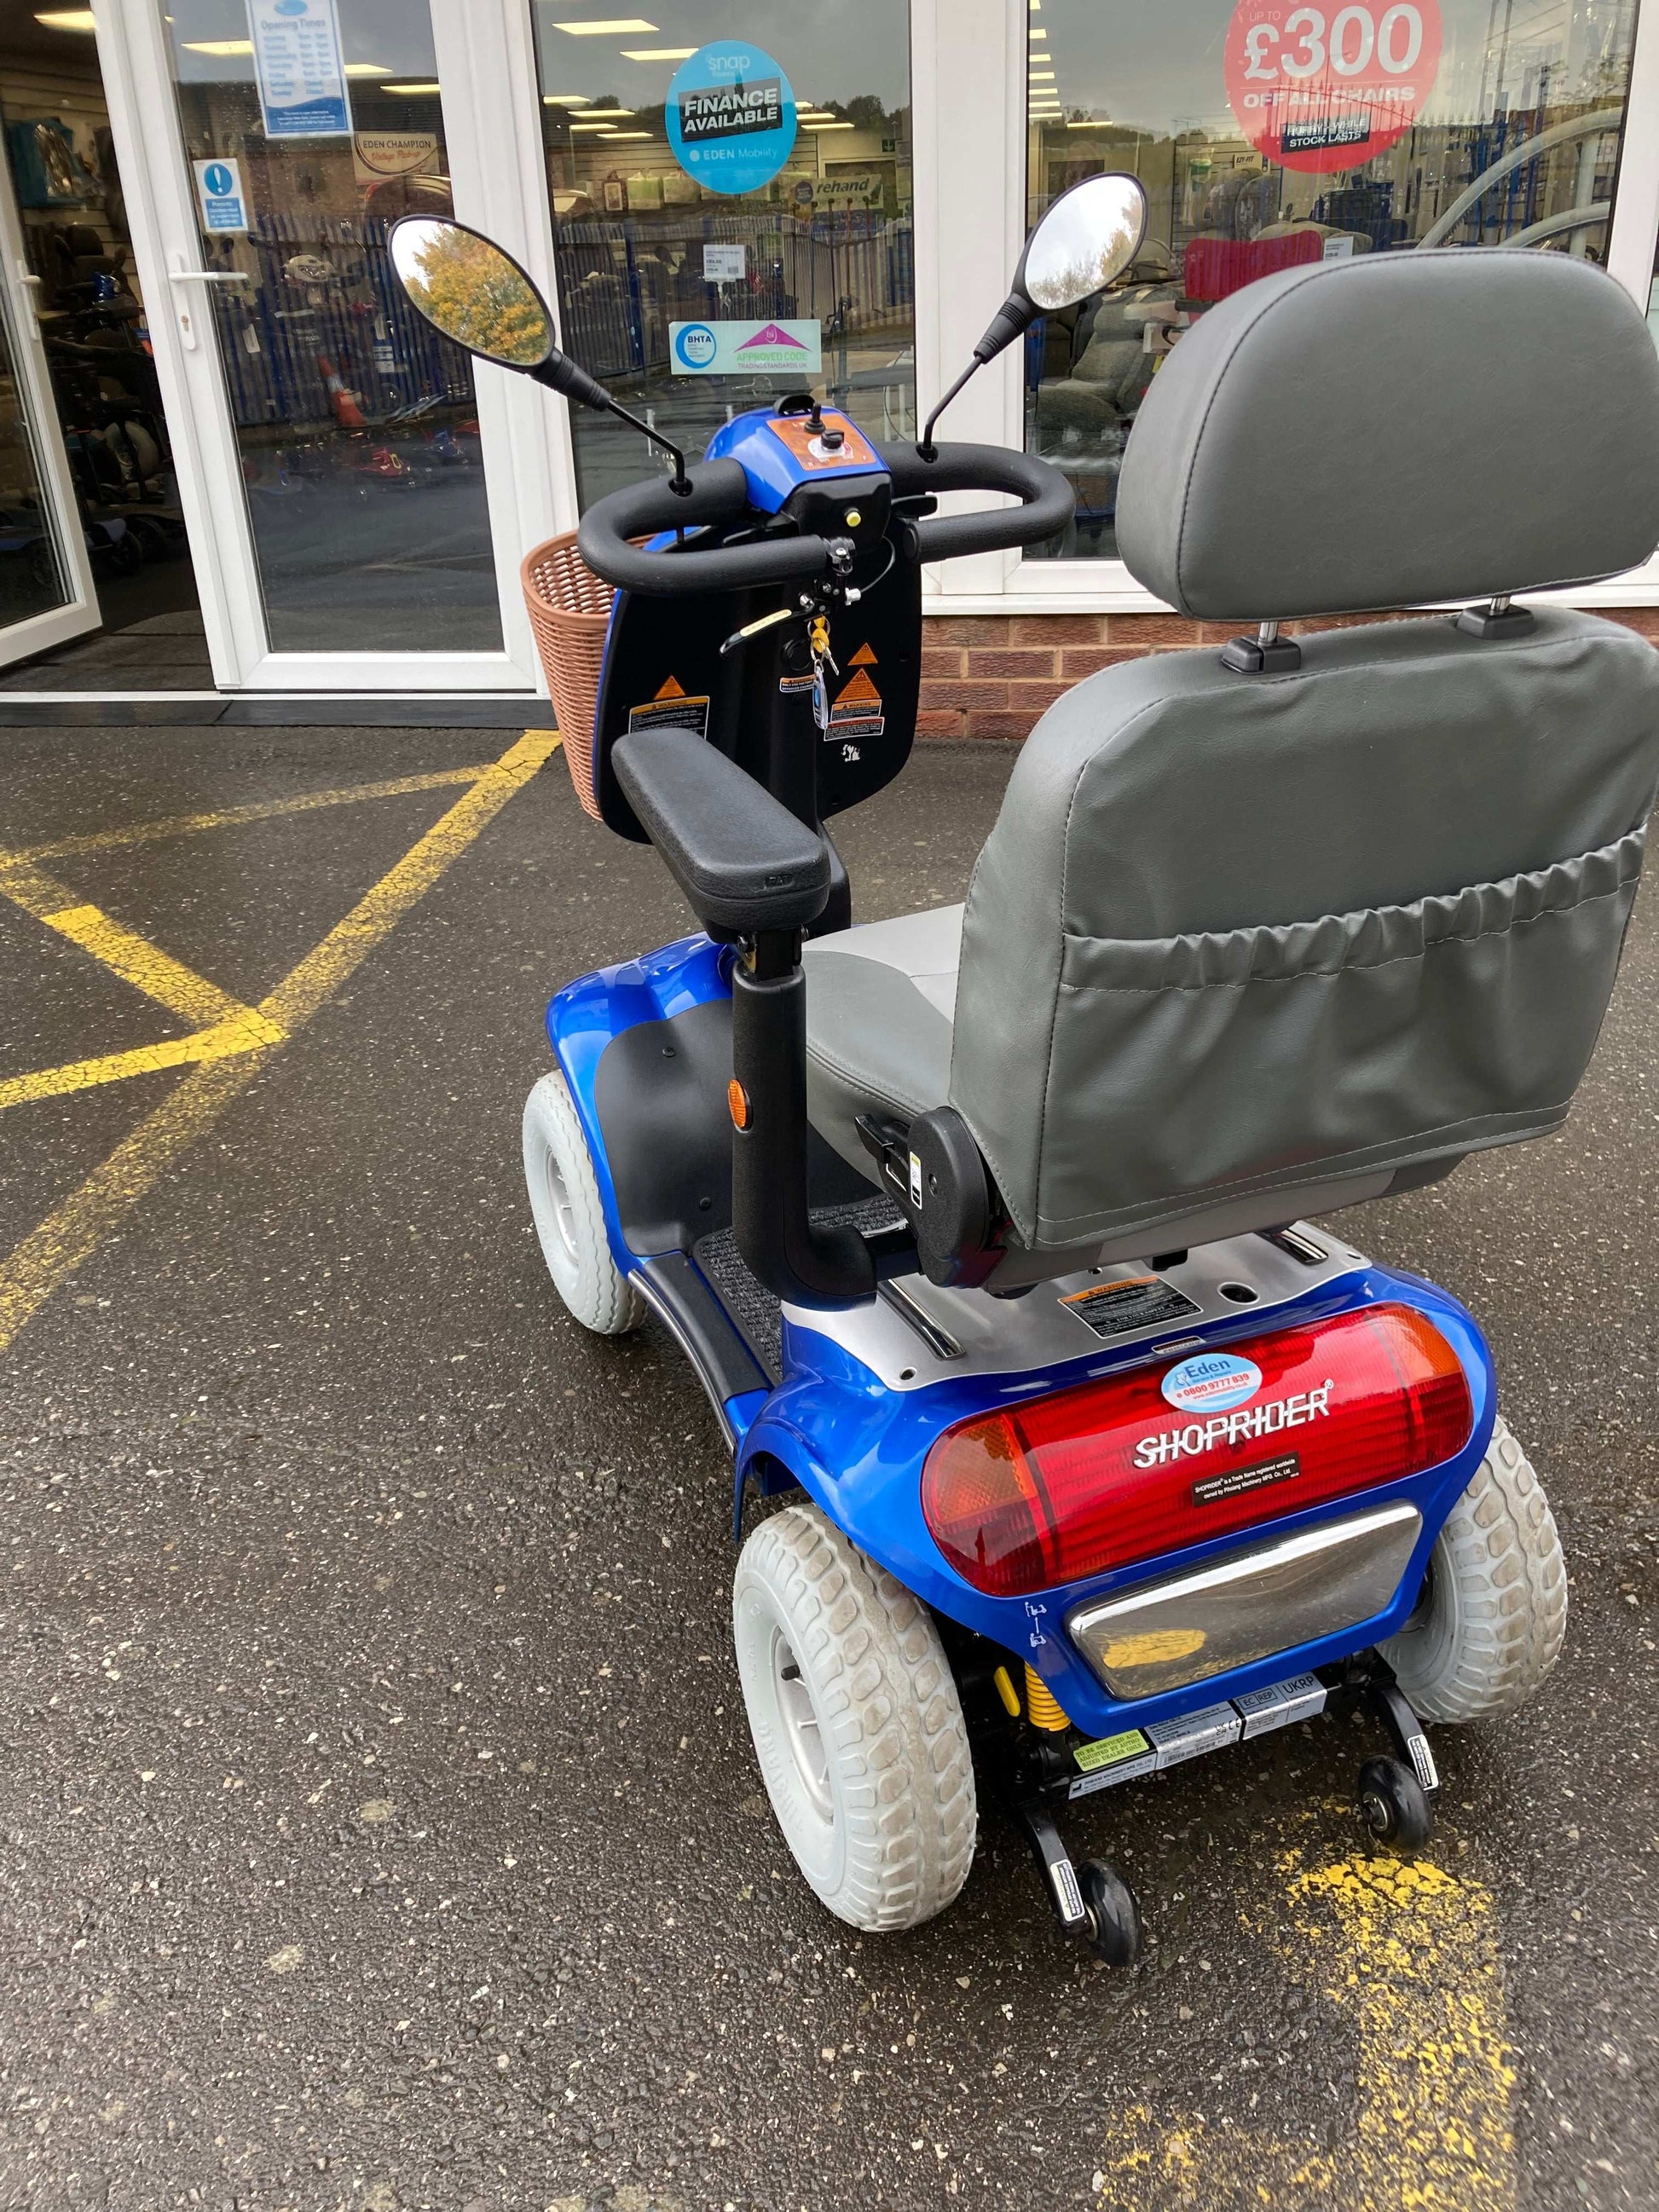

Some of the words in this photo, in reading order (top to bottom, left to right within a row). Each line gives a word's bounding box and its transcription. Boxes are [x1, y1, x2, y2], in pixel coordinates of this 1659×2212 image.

[261, 20, 298, 31] Opening
[299, 19, 326, 27] Times
[1249, 11, 1264, 22] UP
[1266, 10, 1281, 21] TO
[1243, 3, 1423, 81] £300
[708, 55, 750, 73] snap
[685, 88, 777, 117] FINANCE
[1244, 92, 1286, 108] OFF
[1288, 90, 1327, 106] ALL
[1332, 86, 1415, 105] CHAIRS
[684, 107, 777, 133] AVAILABLE
[1332, 118, 1367, 130] WHILE
[362, 140, 384, 148] EDEN
[386, 140, 431, 149] CHAMPION
[1289, 136, 1326, 148] STOCK
[1328, 130, 1361, 143] LASTS
[703, 149, 735, 160] EDEN
[738, 148, 777, 159] Mobility
[817, 178, 870, 193] rehand
[687, 335, 712, 344] BHTA
[737, 352, 783, 361] APPROVED
[784, 351, 808, 361] CODE
[1096, 1280, 1133, 1293] WARNING
[1183, 1360, 1231, 1378] Eden
[1183, 1384, 1208, 1396] 0800
[1208, 1378, 1231, 1390] 9777
[1231, 1373, 1250, 1383] 839
[1244, 1470, 1257, 1479] Name
[1256, 1464, 1276, 1475] registered
[1275, 1458, 1296, 1469] worldwide
[1203, 1491, 1217, 1499] owned
[1241, 1477, 1262, 1487] Machinery
[1282, 1676, 1315, 1694] UKRP
[1243, 1697, 1255, 1707] EC
[1258, 1691, 1273, 1701] REP
[1096, 1737, 1125, 1750] SERVICED
[1126, 1731, 1139, 1741] AND
[1078, 1749, 1109, 1762] ADJUSTED
[1102, 1749, 1125, 1761] DEALER
[1126, 1742, 1142, 1752] ONLY
